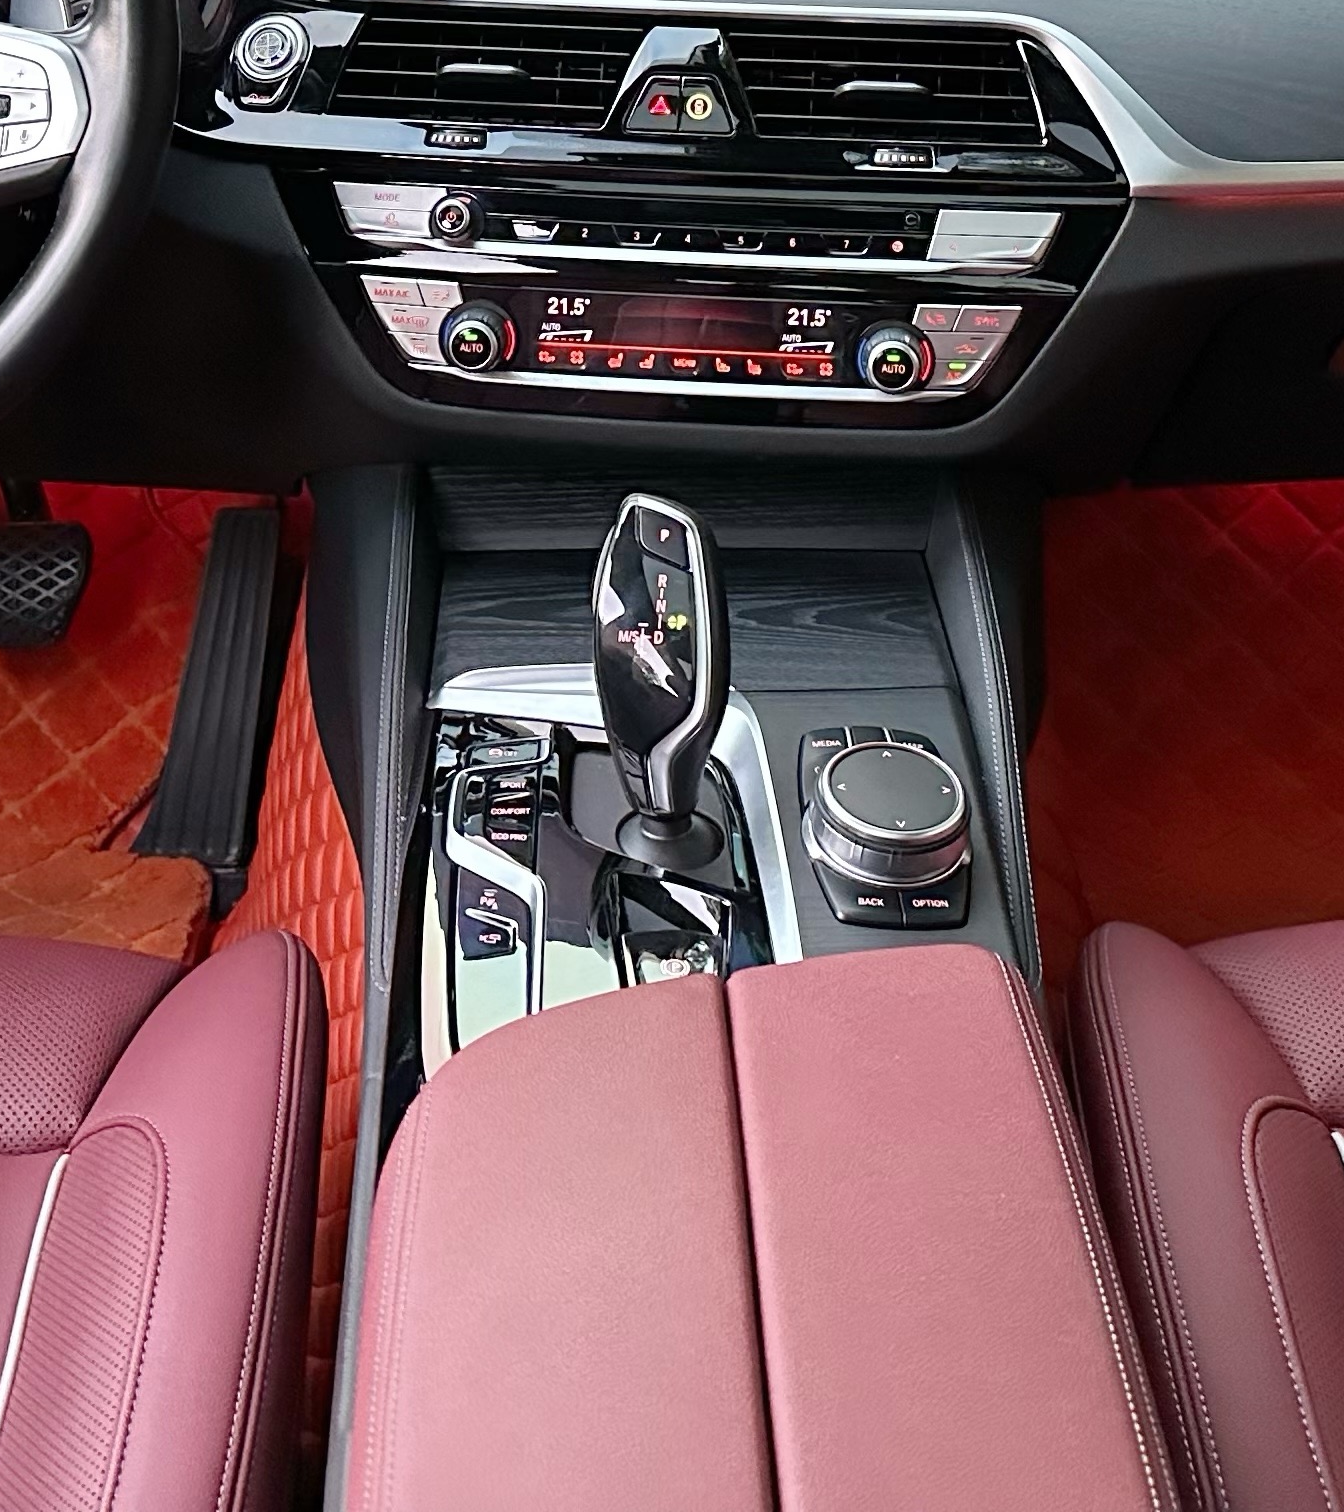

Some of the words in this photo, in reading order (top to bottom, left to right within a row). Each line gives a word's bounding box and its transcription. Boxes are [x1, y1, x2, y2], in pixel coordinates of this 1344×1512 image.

[373, 192, 401, 203] MODE
[391, 315, 411, 324] MAX
[541, 322, 561, 331] AUTO
[782, 333, 802, 342] AUTO
[459, 342, 484, 353] AUTO
[881, 363, 905, 375] AUTO
[660, 528, 670, 542] P
[658, 574, 667, 588] R
[656, 599, 667, 613] N
[653, 630, 664, 645] D
[811, 739, 842, 748] MEDIA
[500, 781, 526, 789] SPORT
[490, 807, 531, 815] COMFORT
[491, 832, 509, 840] ECO
[509, 833, 527, 841] PRO
[858, 897, 884, 907] BACK
[912, 898, 949, 908] OPTION
